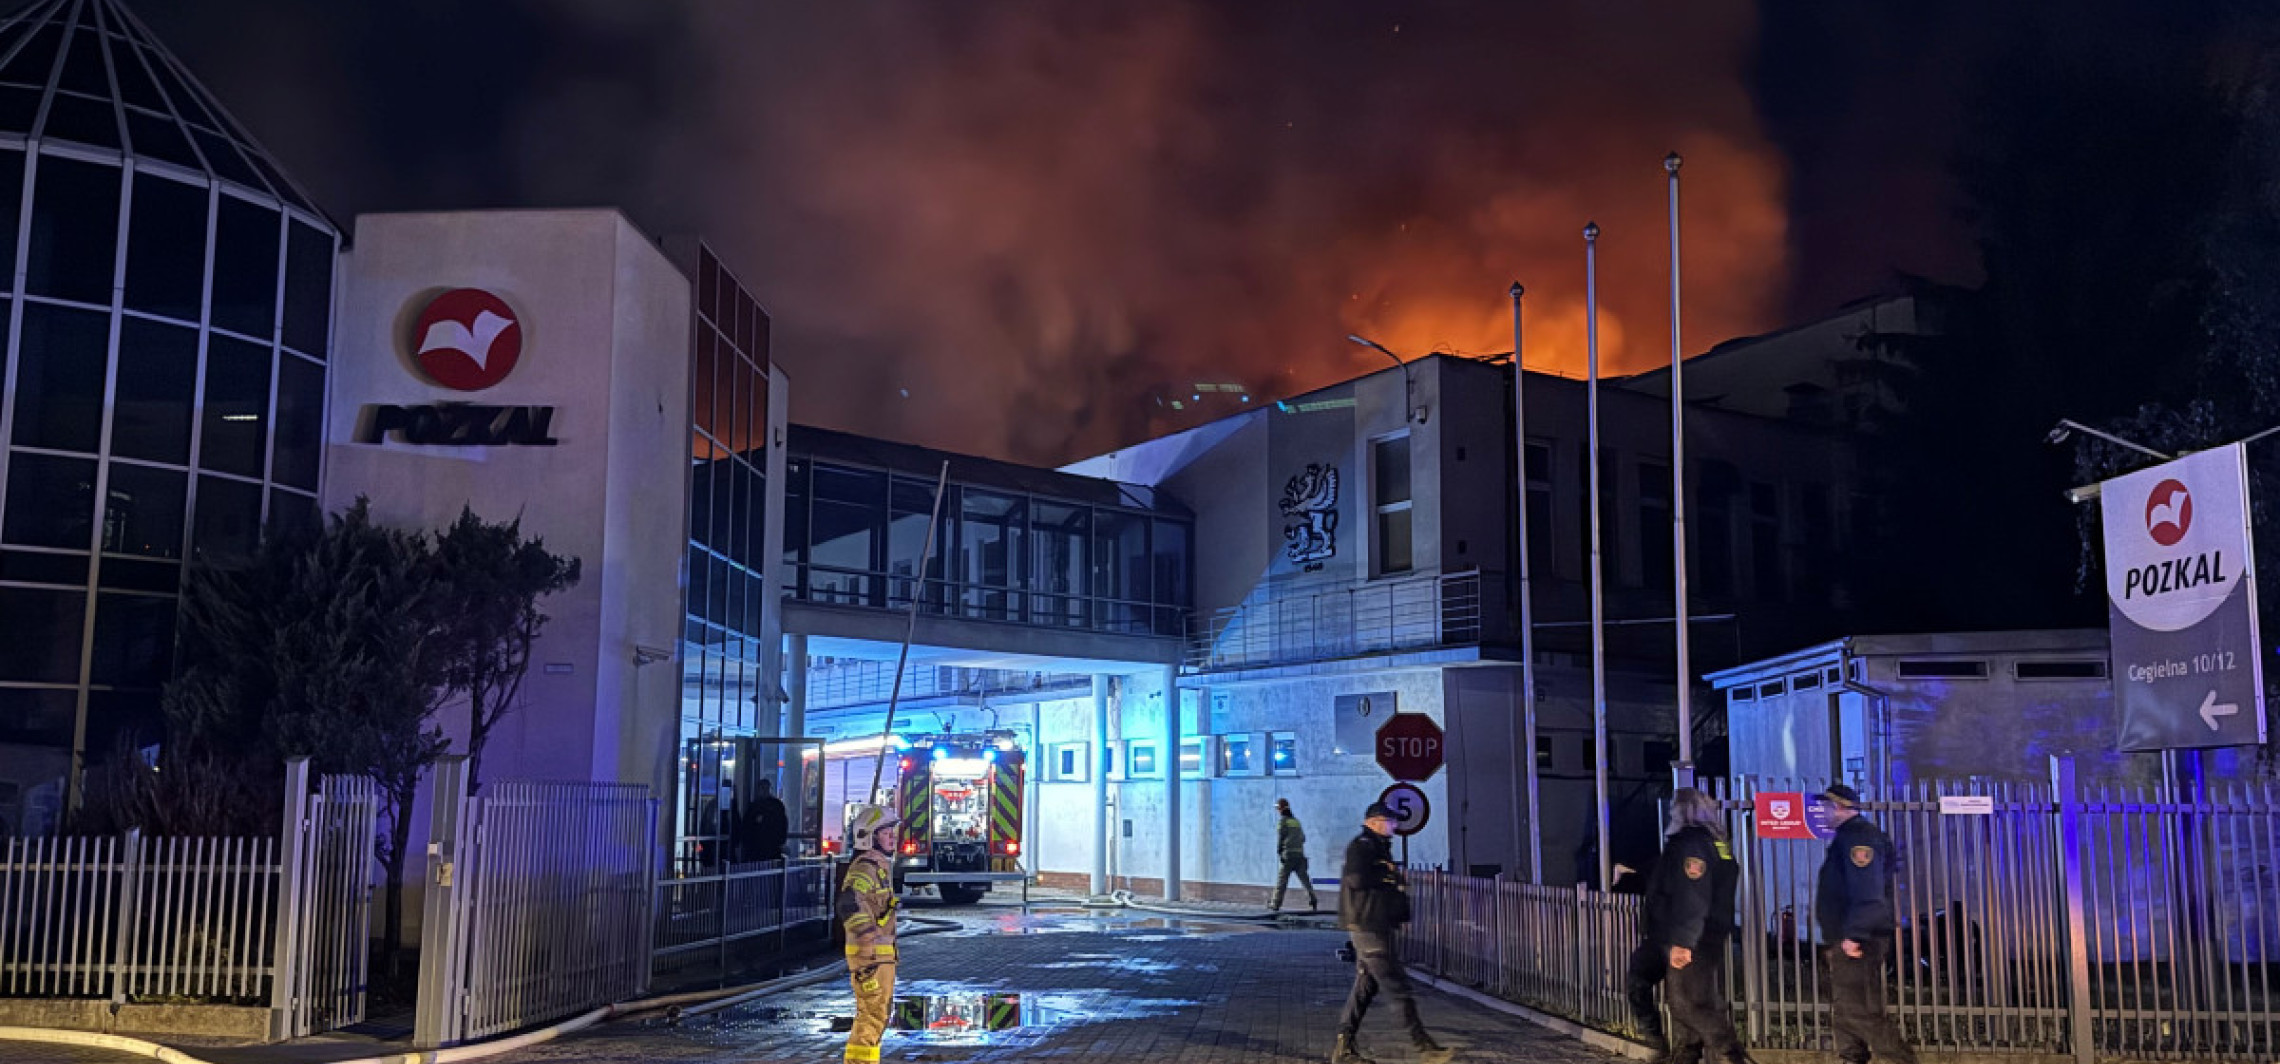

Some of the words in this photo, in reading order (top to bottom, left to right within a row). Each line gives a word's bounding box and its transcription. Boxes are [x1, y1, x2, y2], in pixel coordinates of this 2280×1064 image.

[361, 403, 559, 446] POZKAL
[2125, 550, 2226, 600] POZKAL
[2127, 659, 2188, 683] Cegielna
[2193, 651, 2236, 674] 10/12
[1383, 737, 1438, 758] STOP
[1397, 797, 1412, 821] 5
